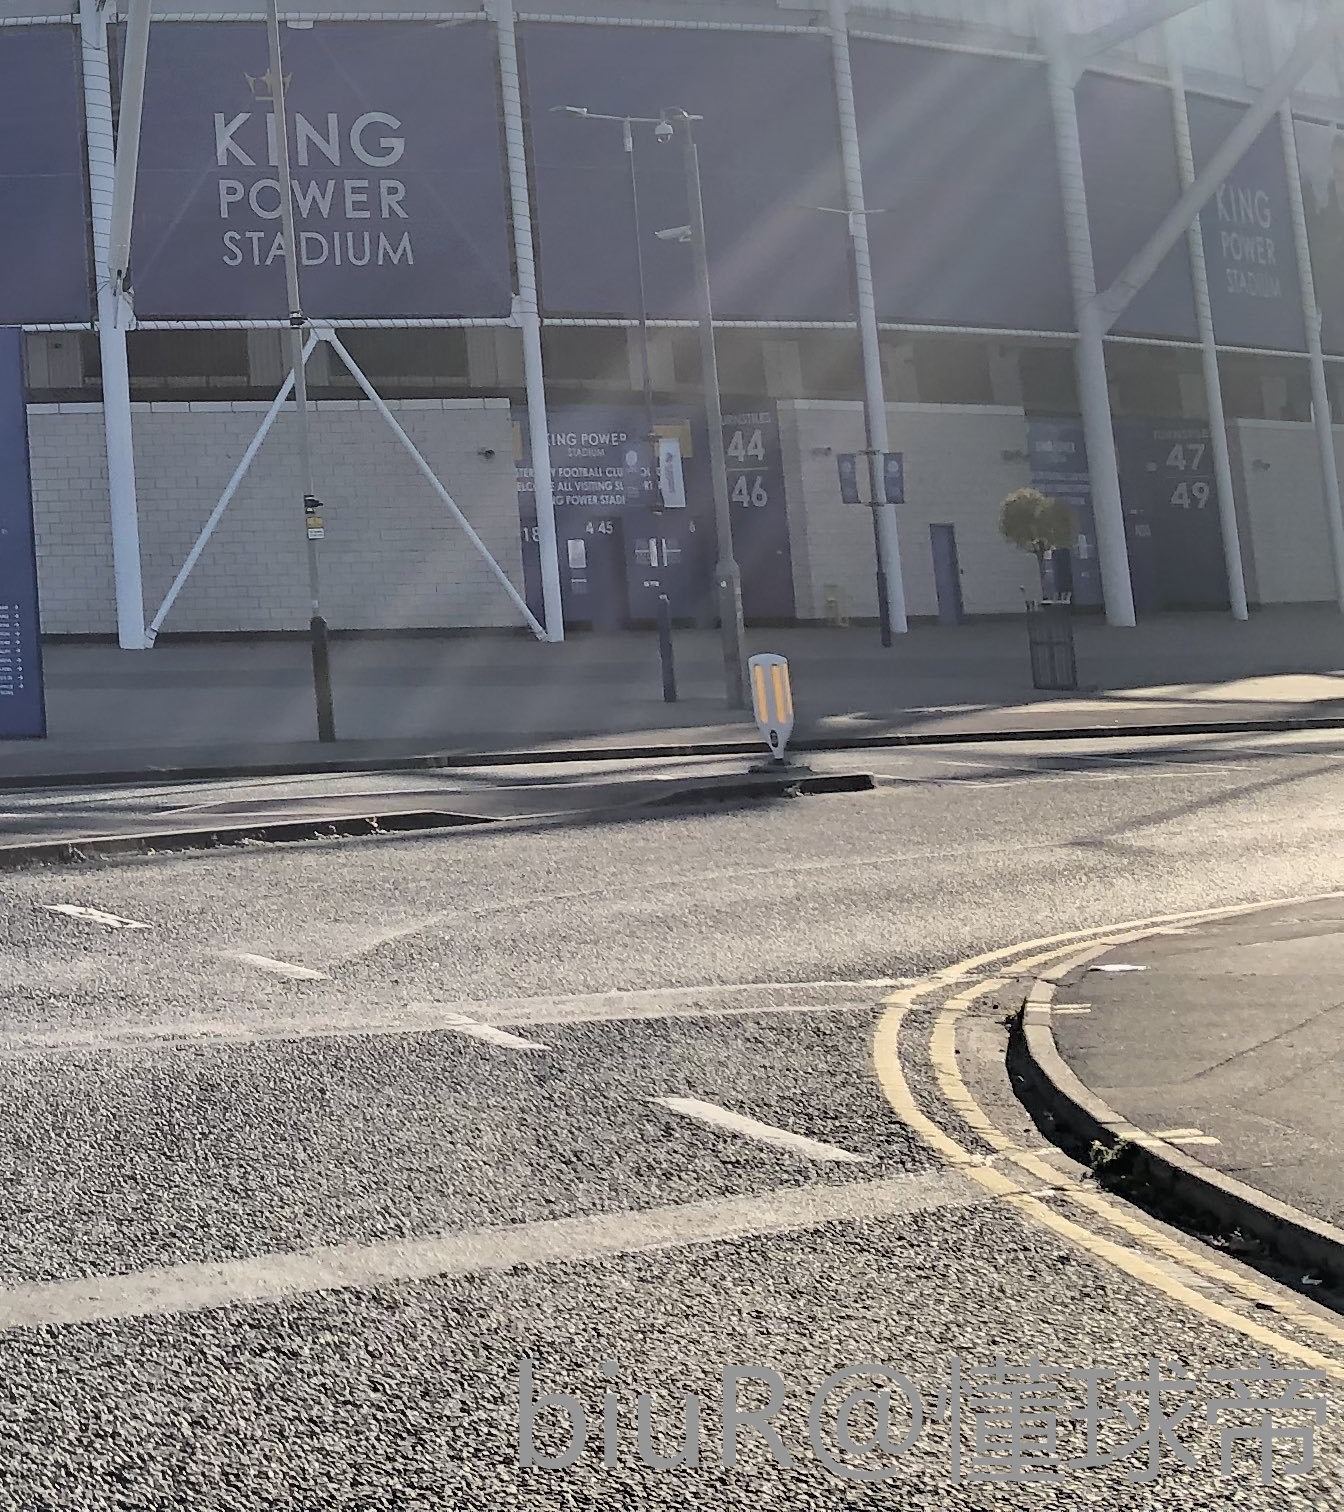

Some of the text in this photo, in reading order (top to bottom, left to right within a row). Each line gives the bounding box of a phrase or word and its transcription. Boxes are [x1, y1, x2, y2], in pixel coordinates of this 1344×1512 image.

[214, 111, 406, 167] KING
[218, 178, 409, 220] POWER
[1215, 183, 1272, 229] KING
[222, 230, 414, 266] STADIUM
[1220, 231, 1276, 265] POWER
[727, 429, 766, 463] 44
[1166, 443, 1206, 471] 47
[605, 467, 624, 478] CLU
[600, 495, 626, 506] STADI
[732, 474, 768, 508] 46
[1170, 481, 1210, 510] 49
